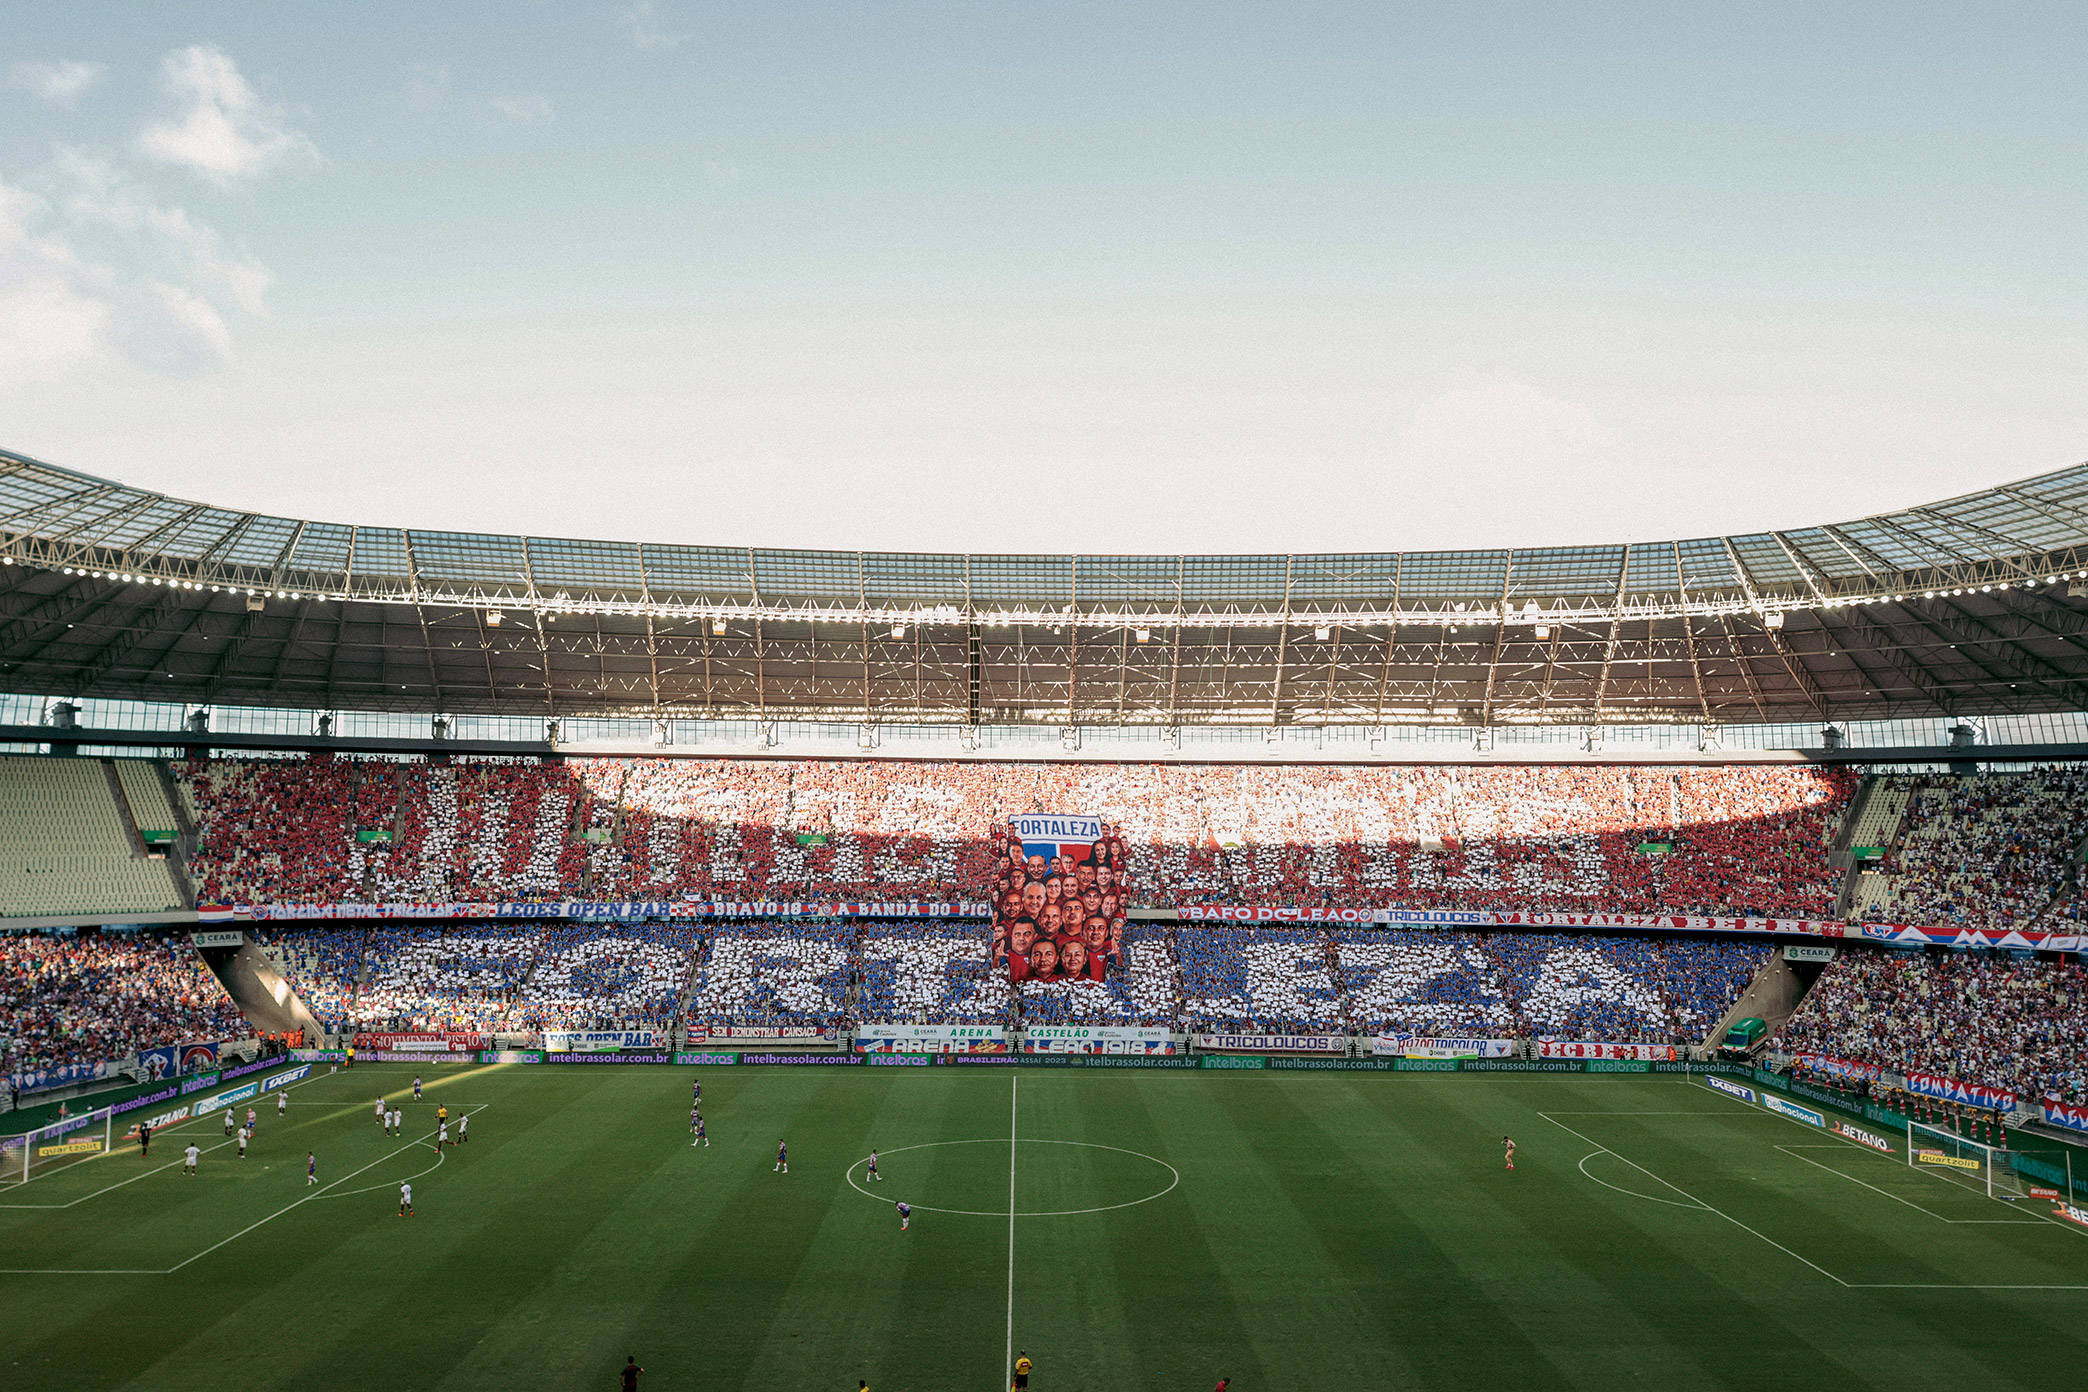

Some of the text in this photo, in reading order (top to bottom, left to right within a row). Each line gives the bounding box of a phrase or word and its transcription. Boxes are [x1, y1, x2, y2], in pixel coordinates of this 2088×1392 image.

[1010, 819, 1100, 837] FORTALEZA
[567, 902, 623, 917] OPEN
[627, 902, 670, 917] BAR
[713, 902, 801, 916] BRAVO 18
[837, 902, 850, 916] A
[858, 902, 919, 917] BANDA
[928, 902, 951, 917] DO
[1189, 906, 1252, 921] BAFO
[1386, 910, 1481, 924] TRICOLOUCOS
[1519, 910, 1802, 932] FORTALEZA BEER
[207, 932, 238, 941] CEARÁ
[1800, 949, 1831, 957] CEARÁ
[712, 1026, 728, 1038] SEM
[731, 1026, 780, 1038] DEMONSTRAR
[949, 1028, 993, 1037] ARENA
[1030, 1027, 1090, 1038] CASTELÃO
[624, 1032, 651, 1047] BAR
[892, 1039, 970, 1054] ARENA
[1215, 1035, 1328, 1049] TRICOLOUCOS
[1102, 1040, 1146, 1055] 1918
[289, 1049, 346, 1062] intelbras
[355, 1051, 475, 1063] intelbrassolar.com.br
[482, 1051, 540, 1063] intelbras
[549, 1052, 669, 1064] intelbrassolar.com.br
[676, 1053, 734, 1065] intelbras
[743, 1053, 863, 1065] intelbrassolar.com.br
[870, 1054, 928, 1066] intelbras
[957, 1055, 1019, 1064] BRASILEIRÃO
[1020, 1055, 1041, 1064] ASSAÍ
[1205, 1056, 1262, 1069] intelbras
[221, 1054, 287, 1080] intelbrassolar.com.br
[1271, 1057, 1390, 1070] intelbrassolar.com.br
[1398, 1059, 1455, 1071] intelbras
[1464, 1059, 1582, 1071] intelbrassolar.com.br
[1590, 1060, 1647, 1073] intelbras
[1655, 1061, 1753, 1077] intelbrassolar.com.br
[181, 1073, 218, 1094] intelbras
[267, 1067, 309, 1088] 1XBET
[1755, 1072, 1787, 1088] intelbras
[1709, 1078, 1748, 1097] 1XBET
[1790, 1082, 1863, 1114] intelbrassolar.com.br
[1842, 1124, 1888, 1150] BETANO
[41, 1142, 98, 1156] quartzolit
[1922, 1154, 1977, 1168] quartzolit
[2031, 1187, 2058, 1197] BETANO
